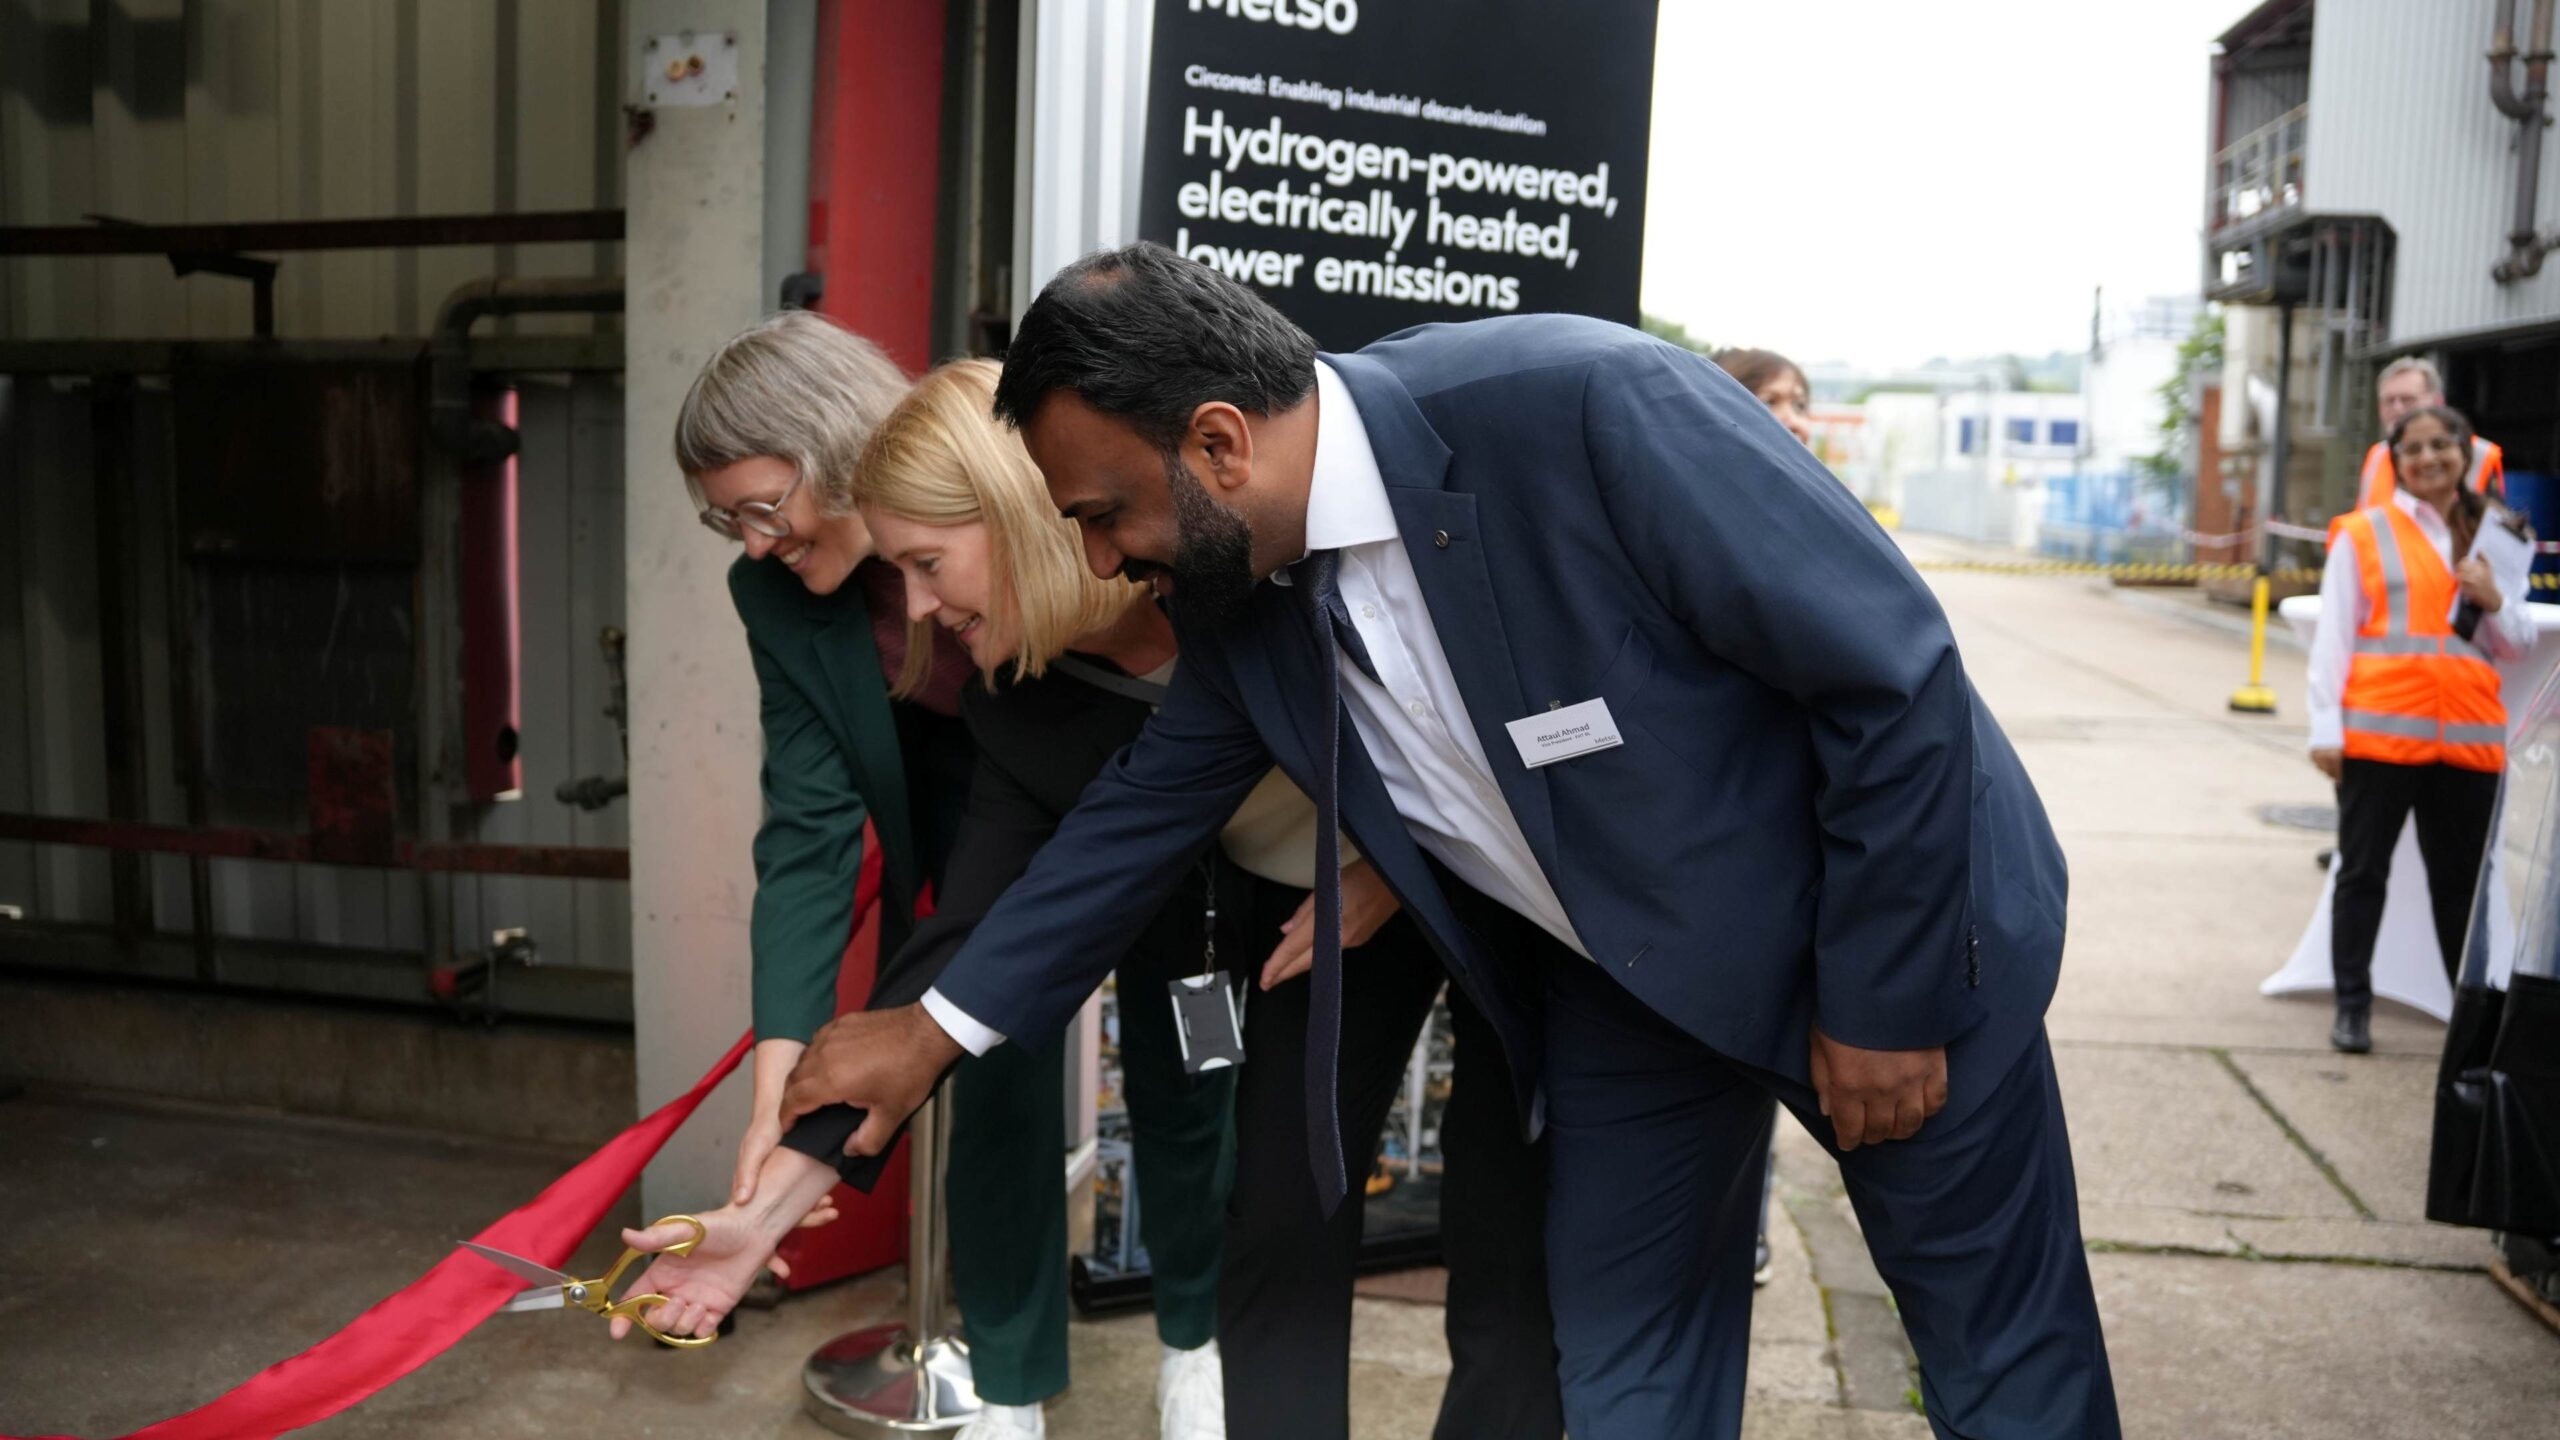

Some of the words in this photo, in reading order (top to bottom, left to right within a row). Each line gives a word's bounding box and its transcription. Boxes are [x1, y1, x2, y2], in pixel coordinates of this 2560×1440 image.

[1188, 0, 1359, 35] etso
[1184, 64, 1266, 95] Circored:
[1268, 75, 1344, 111] Enabling
[1345, 86, 1421, 117] industrial
[1421, 98, 1547, 136] decarbonization
[1183, 106, 1619, 218] Hydrogen-powered,
[1177, 171, 1417, 251] electrically
[1427, 196, 1580, 270] heated,
[1177, 227, 1304, 288] lower
[1314, 250, 1520, 311] emissions
[1537, 730, 1561, 743] Attaul
[1562, 722, 1590, 737] Ahmad
